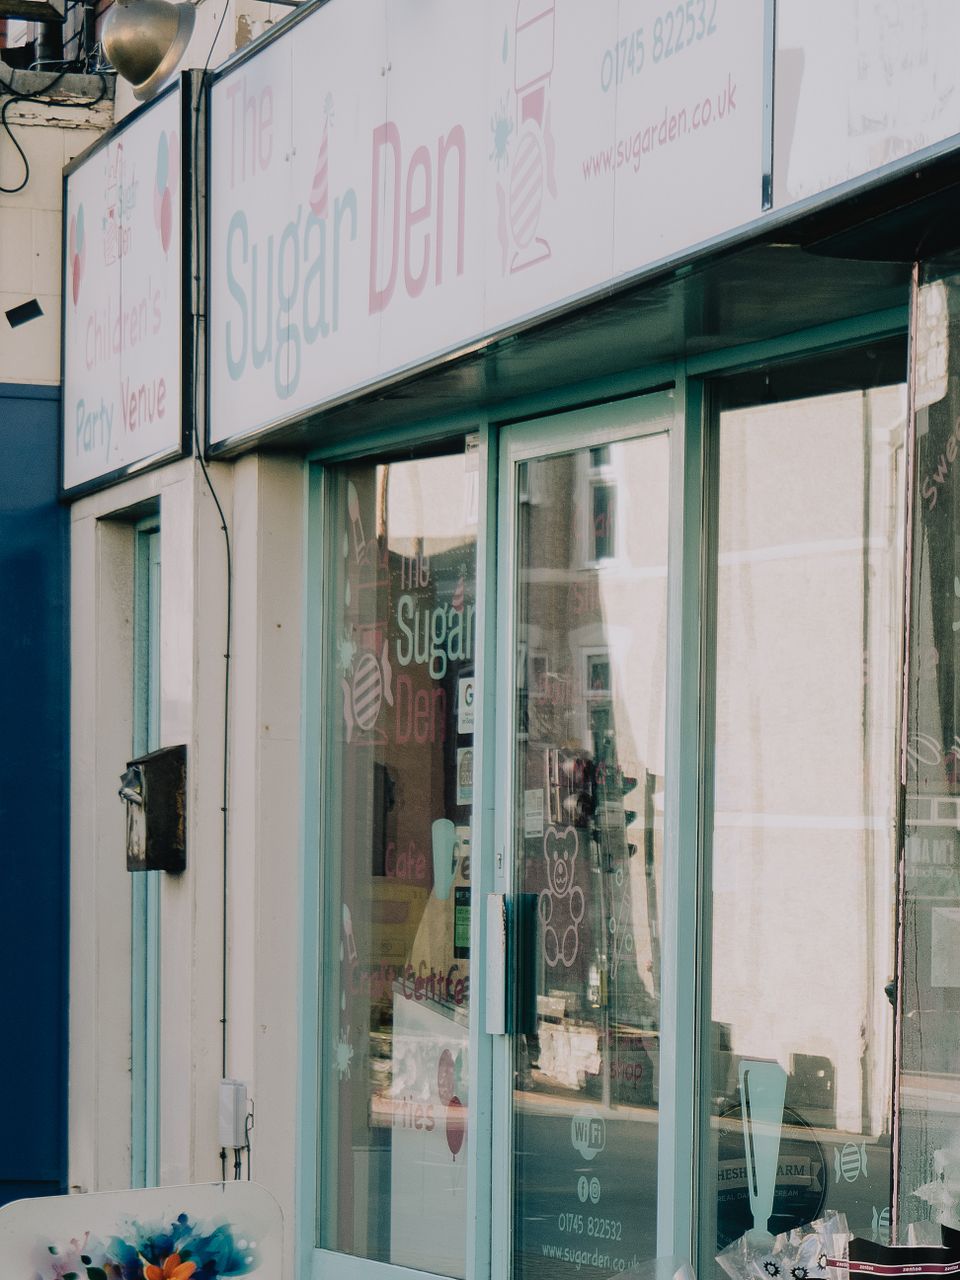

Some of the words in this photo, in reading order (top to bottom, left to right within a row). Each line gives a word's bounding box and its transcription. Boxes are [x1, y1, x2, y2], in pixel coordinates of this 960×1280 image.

[600, 27, 645, 93] 01745
[652, 0, 717, 64] 822532
[226, 76, 274, 190] The
[582, 72, 737, 181] www.sugarden.co.uk
[226, 187, 357, 400] Sugar
[368, 120, 467, 317] Den
[85, 287, 163, 372] Children's
[75, 398, 114, 464] Party
[120, 376, 167, 434] Venue
[396, 594, 475, 681] Sugar
[396, 674, 447, 745] Den
[774, 1164, 805, 1176] ARM
[558, 1212, 584, 1234] 01745
[587, 1216, 622, 1241] 822532
